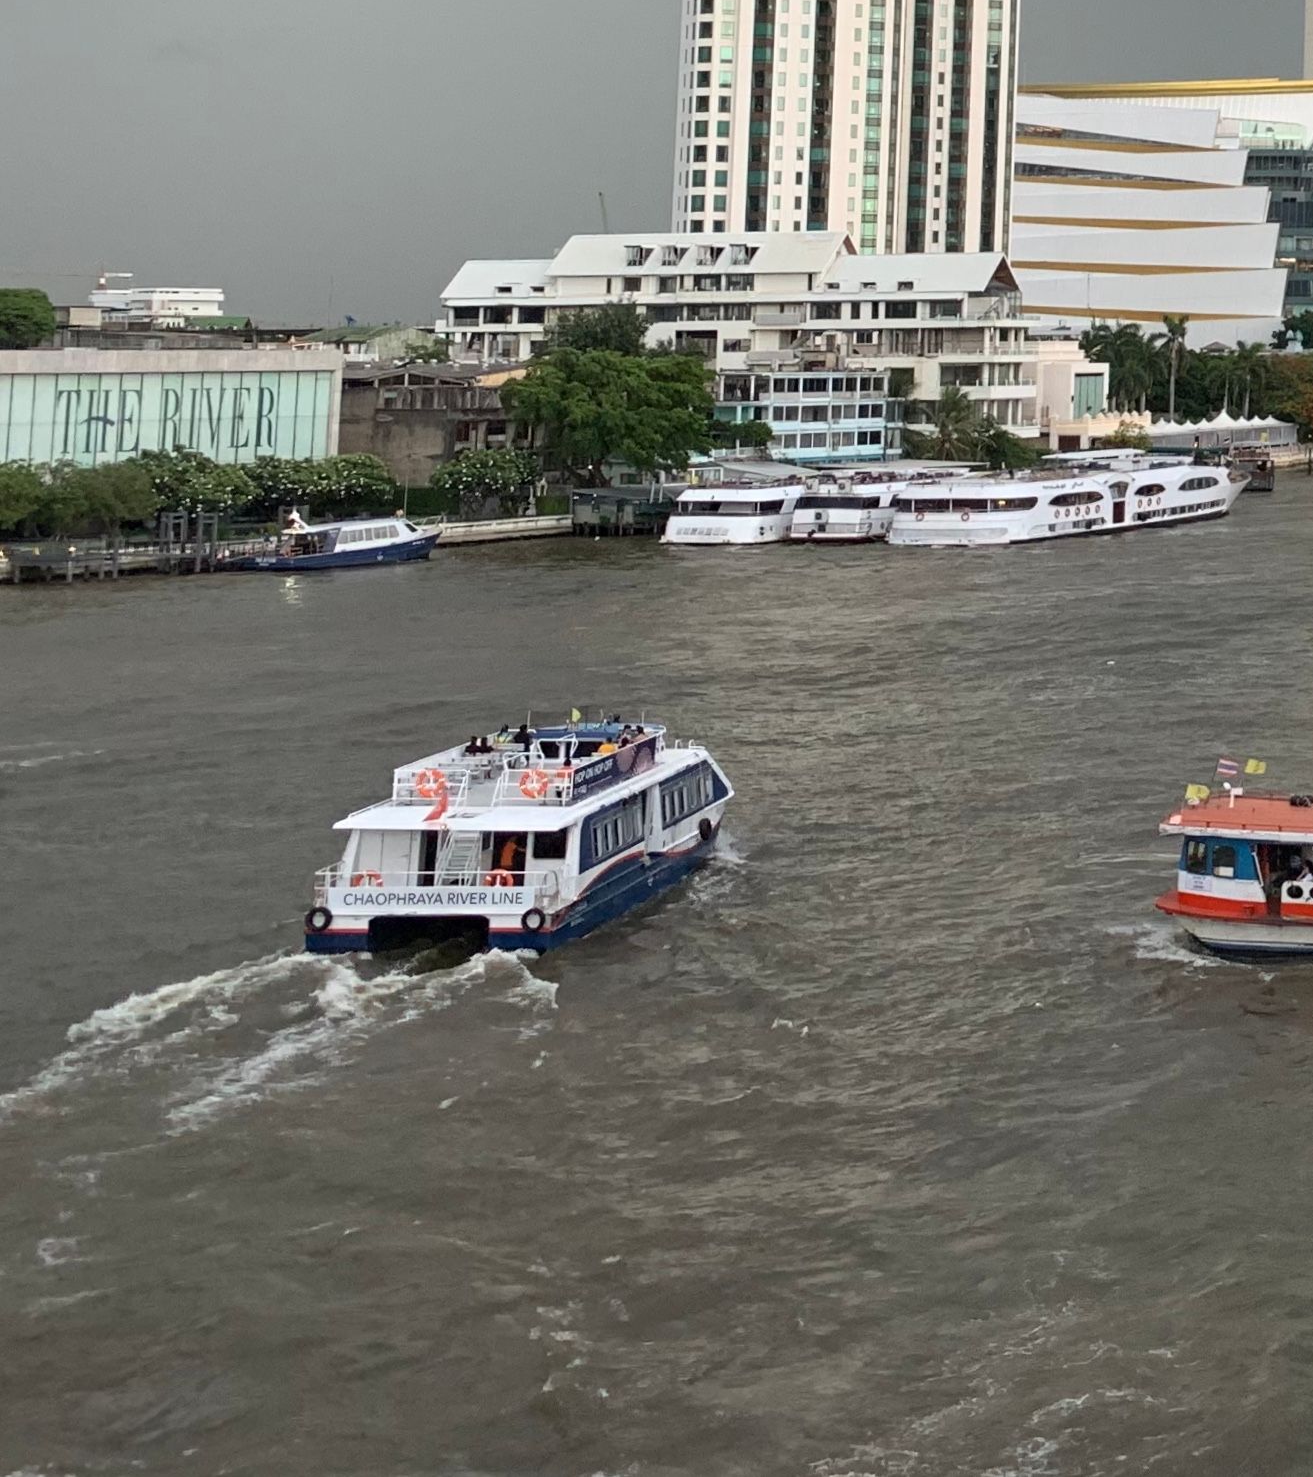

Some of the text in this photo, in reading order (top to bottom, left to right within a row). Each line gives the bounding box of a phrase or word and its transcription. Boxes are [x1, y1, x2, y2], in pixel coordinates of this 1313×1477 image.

[56, 386, 276, 454] THE RIVER
[343, 892, 523, 906] CHAOPHRAYA RIVER LINE
